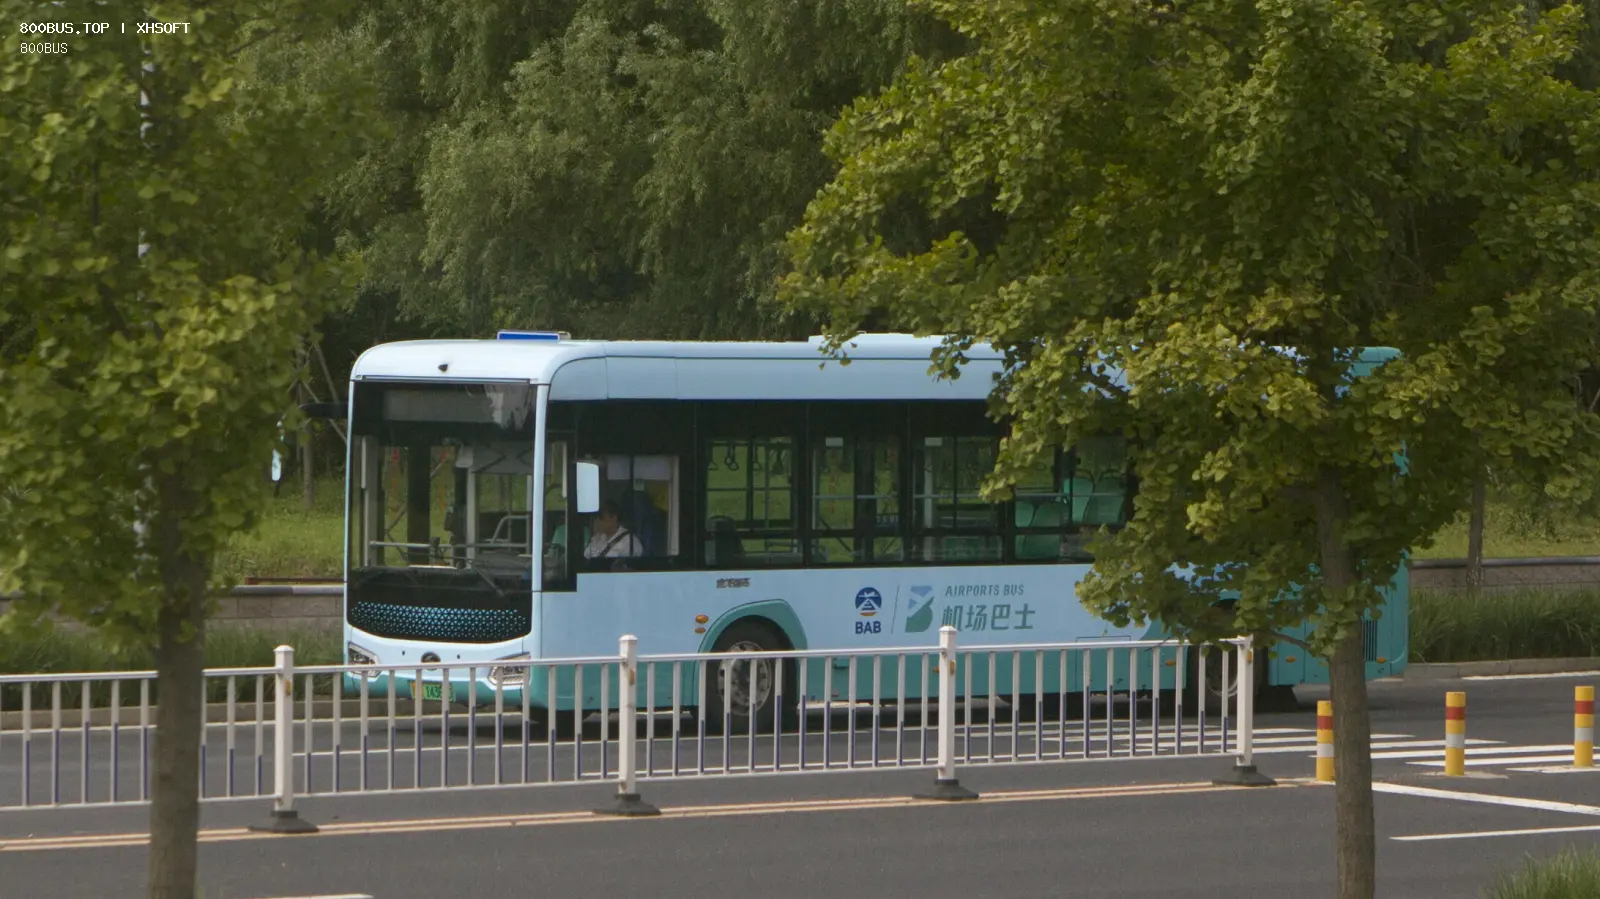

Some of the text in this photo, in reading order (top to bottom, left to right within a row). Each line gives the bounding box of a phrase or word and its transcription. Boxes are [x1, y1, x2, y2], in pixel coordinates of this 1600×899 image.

[945, 584, 1024, 597] AIRPORTS BUS
[942, 603, 1036, 631] 机场巴士
[855, 621, 882, 634] BAB
